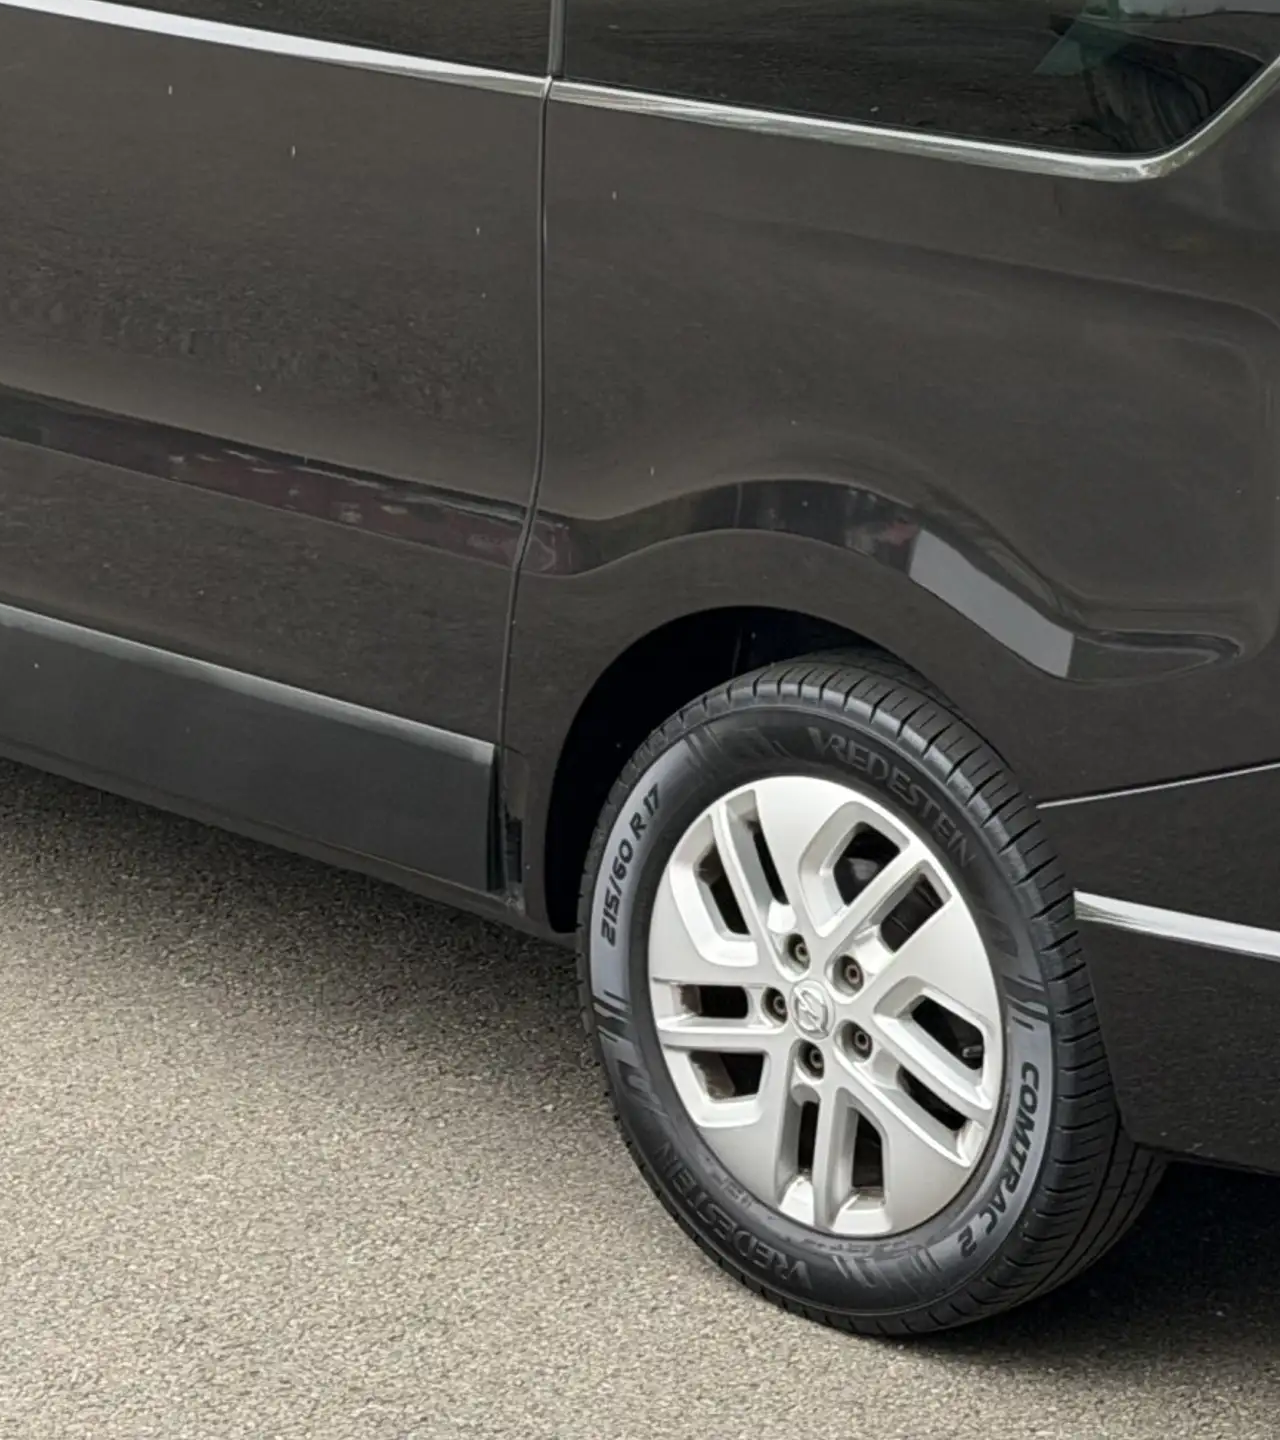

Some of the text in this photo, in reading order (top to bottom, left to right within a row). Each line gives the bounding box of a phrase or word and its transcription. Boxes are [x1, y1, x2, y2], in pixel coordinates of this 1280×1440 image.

[600, 783, 661, 948] 215/60 R 17
[807, 727, 976, 868] VREDESTEIN
[958, 1061, 1040, 1257] COMTRAC 2
